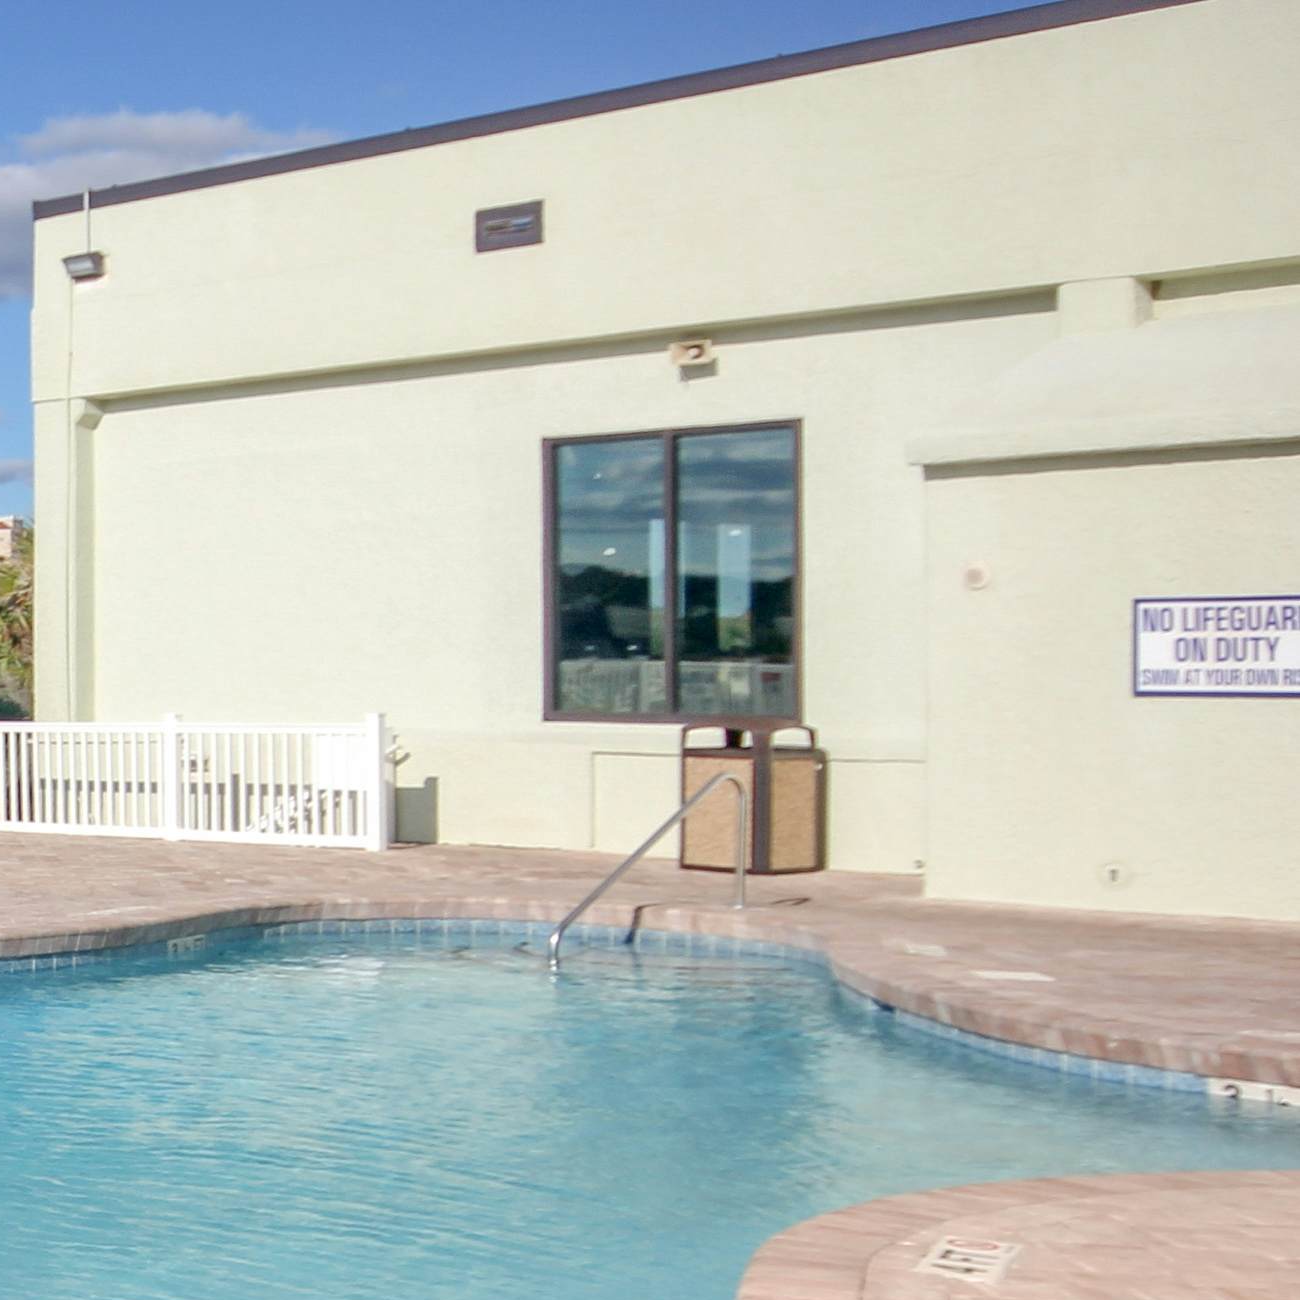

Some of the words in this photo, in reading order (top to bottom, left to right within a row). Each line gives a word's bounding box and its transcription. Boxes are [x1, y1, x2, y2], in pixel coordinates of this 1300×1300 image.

[1143, 608, 1173, 631] NO
[1182, 606, 1300, 631] LIFEGUAR
[1175, 637, 1206, 662] ON
[1216, 637, 1280, 662] DUTY
[1142, 669, 1178, 686] SWIM
[1184, 669, 1201, 686] AT
[1205, 669, 1242, 686] YOUR
[1246, 668, 1279, 686] OWN
